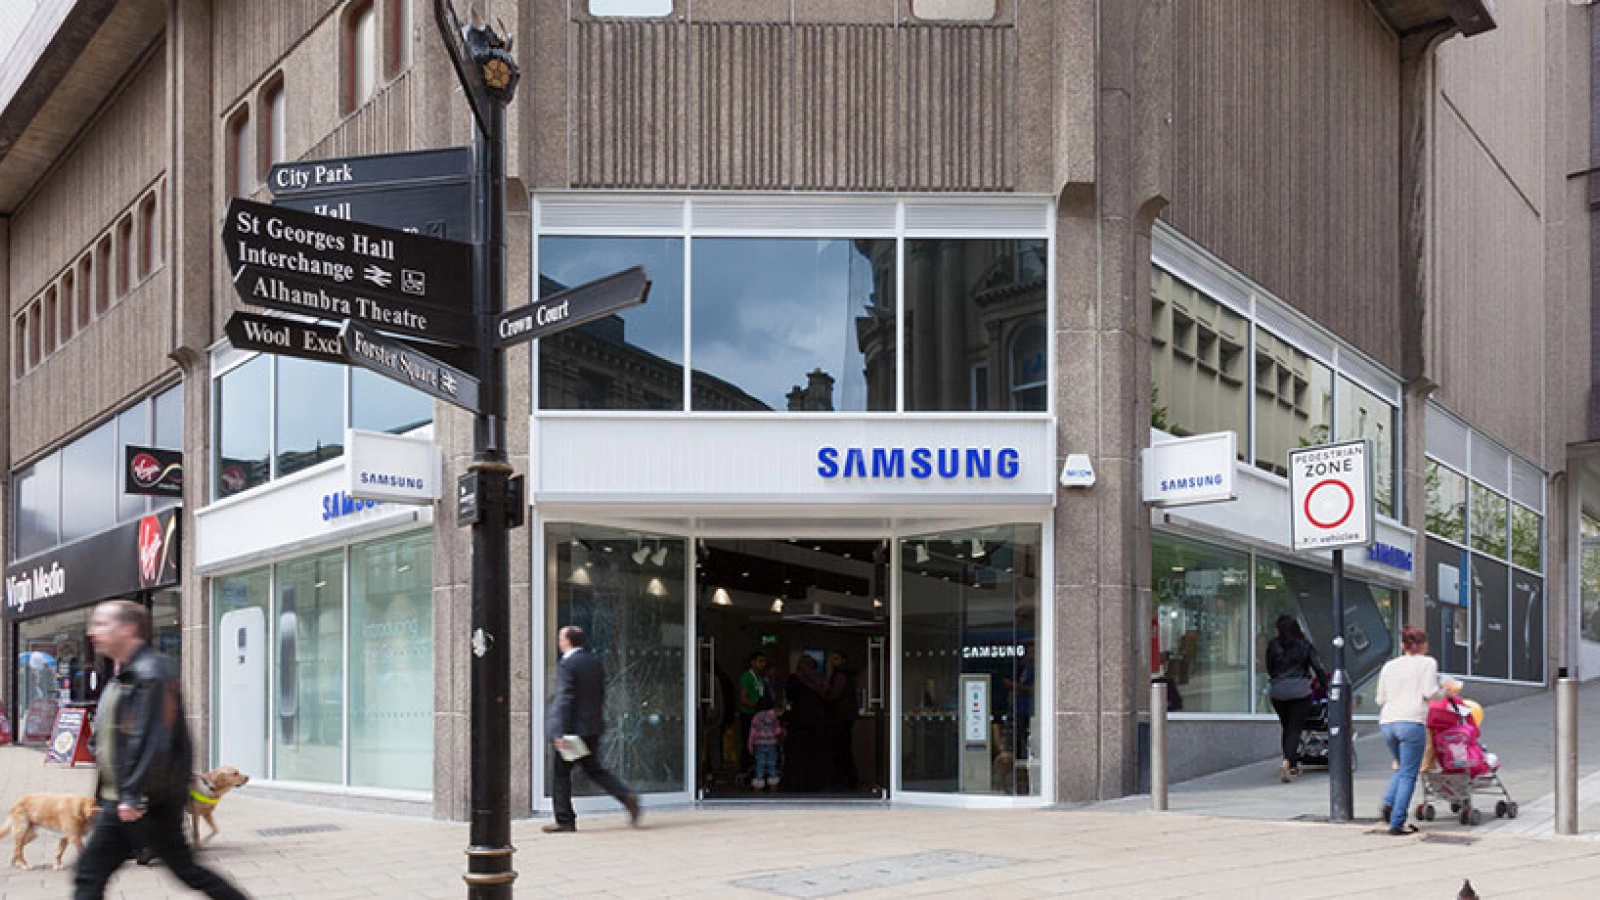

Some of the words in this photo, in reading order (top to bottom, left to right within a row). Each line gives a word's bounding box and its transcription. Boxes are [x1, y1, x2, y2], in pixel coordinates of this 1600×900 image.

[277, 169, 309, 188] City
[315, 164, 352, 184] Park
[237, 211, 260, 236] St
[267, 217, 345, 251] Georges
[352, 233, 394, 260] Hall
[238, 241, 354, 281] Interchange
[252, 277, 350, 315] Alhambra
[356, 297, 428, 330] Theatre
[243, 320, 291, 347] Wool
[499, 316, 533, 339] Crown
[537, 299, 569, 326] Court
[355, 330, 397, 369] Forster
[400, 351, 437, 387] Square
[817, 447, 1020, 479] SAMSUNG
[1296, 446, 1363, 464] PEDESTRIAN
[1305, 458, 1353, 477] ZONE
[361, 472, 424, 490] SAMSUNG
[1161, 473, 1223, 492] SAMSUNG
[6, 572, 32, 612] Virgin
[33, 561, 66, 600] Media
[962, 645, 1026, 658] SAMSUNG
